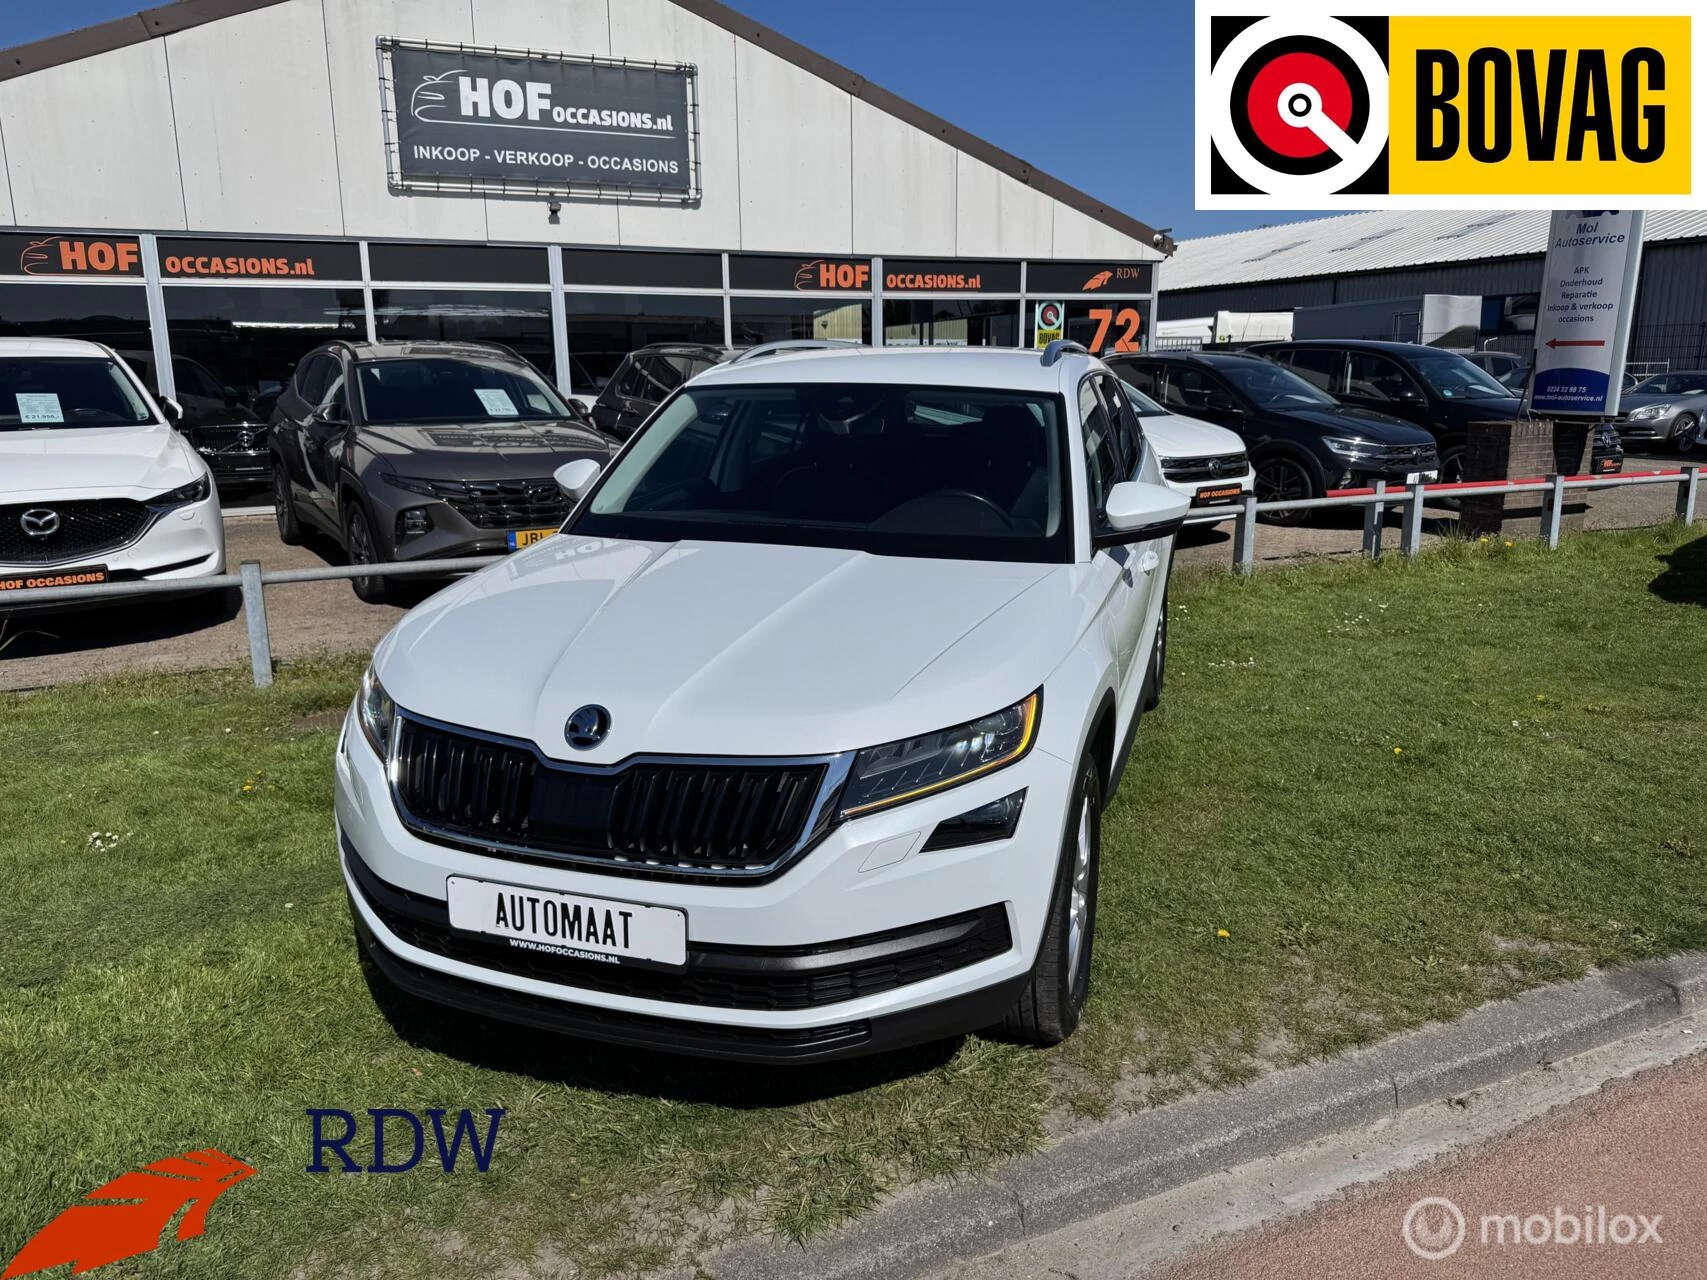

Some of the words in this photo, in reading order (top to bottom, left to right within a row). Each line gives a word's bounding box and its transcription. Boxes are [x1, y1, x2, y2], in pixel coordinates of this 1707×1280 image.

[459, 76, 552, 121] HOF
[552, 105, 673, 131] OCCASIONS.nl
[413, 146, 480, 162] INKOOP
[494, 150, 574, 168] VERKOOP
[588, 156, 679, 174] OCCASIONS
[1576, 222, 1599, 235] Mol
[1555, 233, 1625, 248] Autoservice
[59, 241, 138, 271] HOF
[165, 256, 314, 275] OCCASIONS.nl
[819, 263, 869, 288] HOF
[886, 274, 981, 289] OCCASIONS.nl
[1116, 267, 1140, 279] RDW
[1574, 266, 1590, 274] APK
[1560, 278, 1603, 288] Onderhoud
[1561, 290, 1597, 300] Reparatie
[1547, 304, 1569, 312] Inkoop
[1580, 302, 1613, 311] verkoop
[1089, 308, 1140, 353] 72
[0, 580, 23, 589] HOF
[26, 572, 105, 588] OCCASIONS
[496, 892, 633, 949] AUTOMAAT
[509, 938, 621, 965] WWW.HOFOCCASIONS.NL
